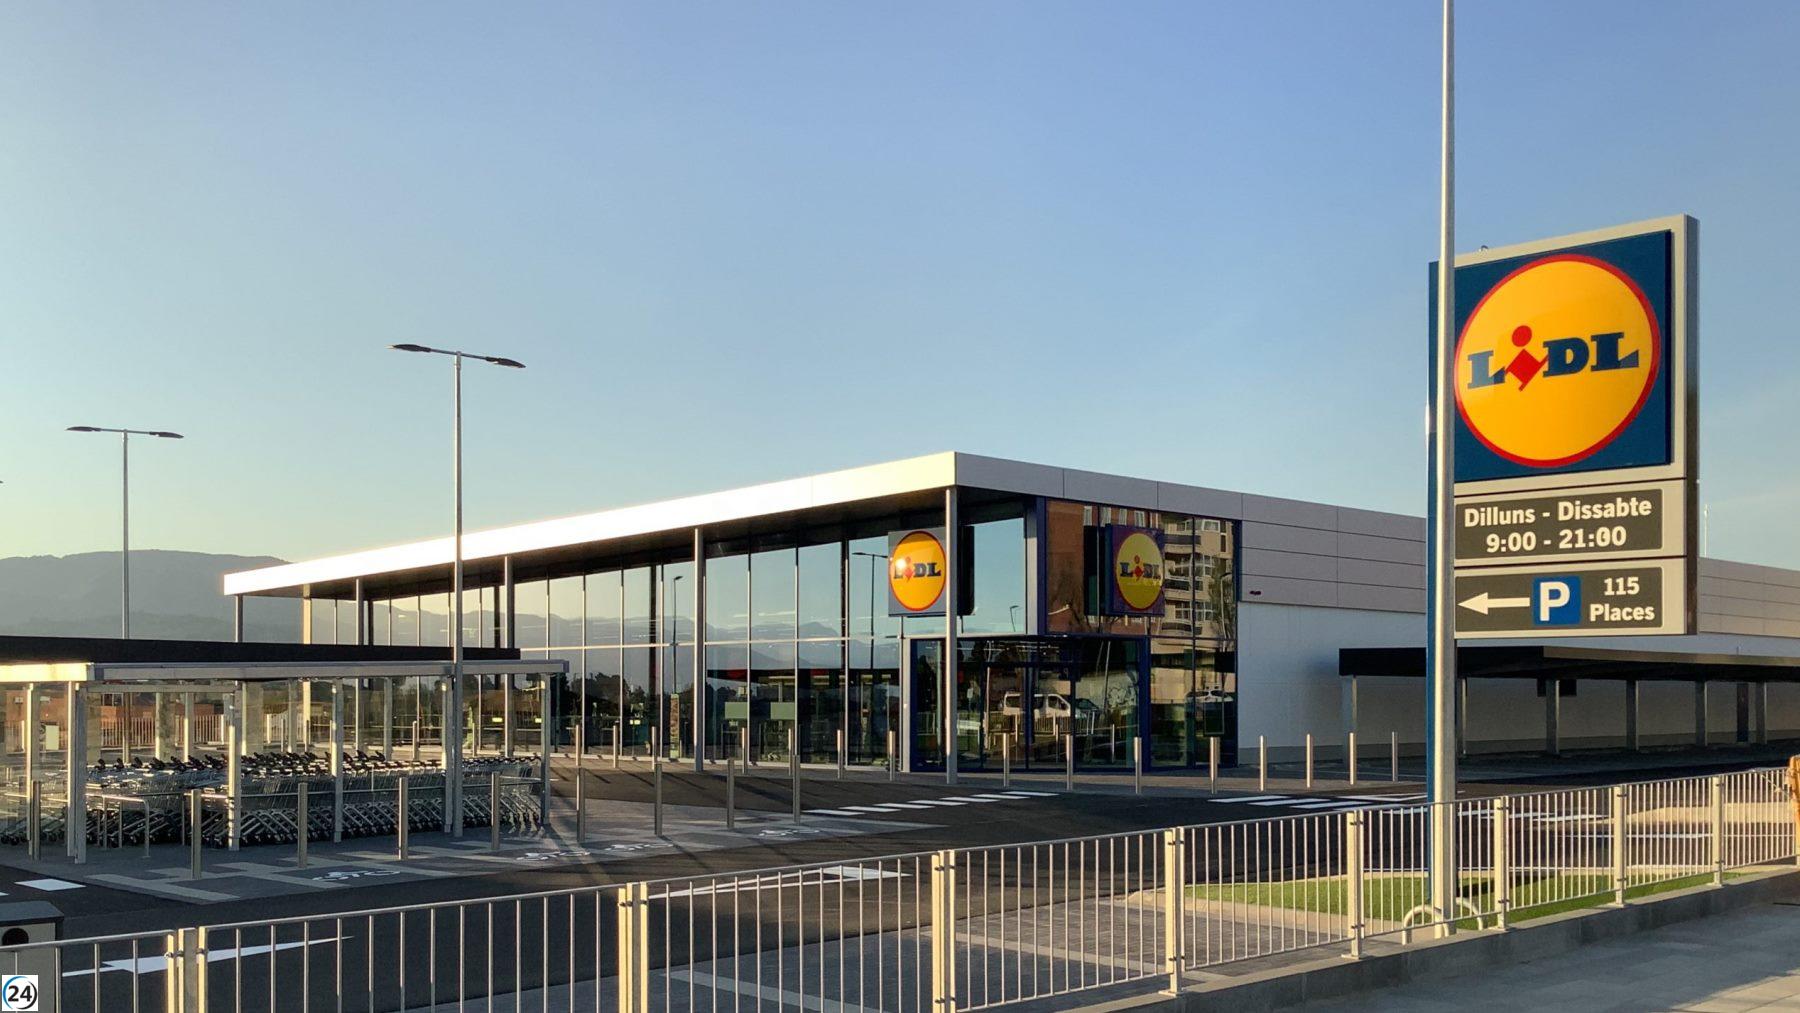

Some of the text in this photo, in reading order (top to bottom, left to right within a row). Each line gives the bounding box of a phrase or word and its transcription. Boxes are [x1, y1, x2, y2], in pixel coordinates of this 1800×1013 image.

[1464, 507, 1536, 527] Dilluns
[1558, 497, 1652, 521] Dissabte
[1486, 532, 1536, 553] 9:00
[1559, 526, 1627, 549] 21:00
[1603, 577, 1639, 596] 115
[1539, 581, 1571, 621] P
[1589, 603, 1655, 622] Places
